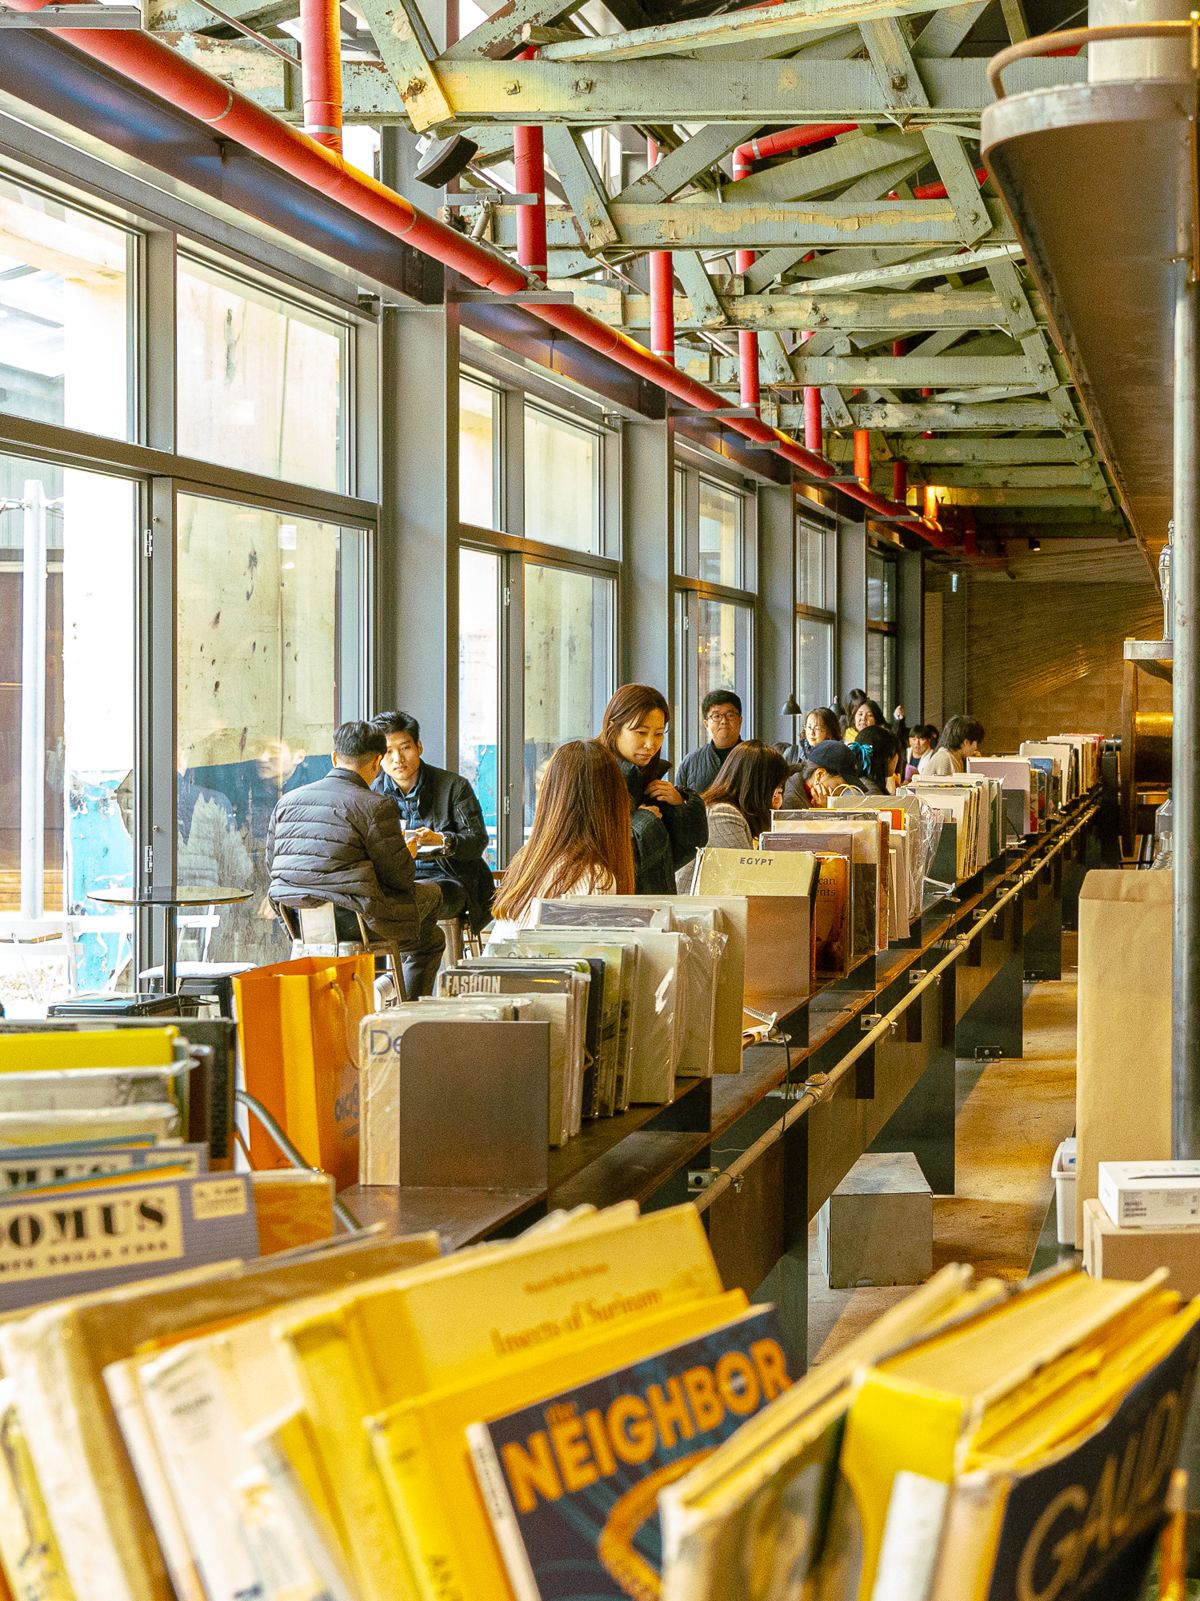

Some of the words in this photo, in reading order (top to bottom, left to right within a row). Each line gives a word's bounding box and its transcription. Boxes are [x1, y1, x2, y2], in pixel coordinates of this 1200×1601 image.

[739, 857, 774, 867] EGYPT
[445, 975, 501, 995] FASHION
[0, 1196, 166, 1248] OMUS
[502, 1338, 795, 1514] NEIGHBOR
